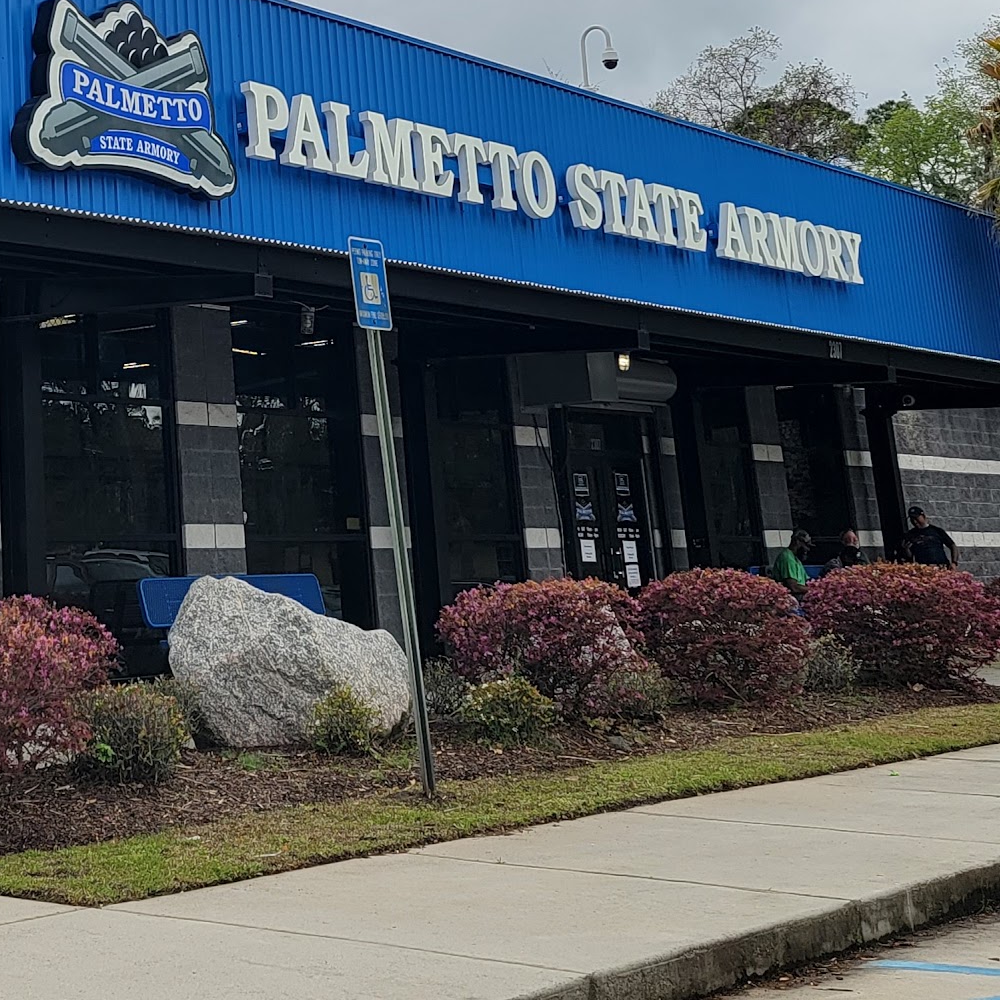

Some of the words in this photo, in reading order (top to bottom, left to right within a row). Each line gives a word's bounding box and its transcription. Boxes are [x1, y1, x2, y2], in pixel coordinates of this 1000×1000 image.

[72, 68, 203, 122] PALMETTO
[100, 135, 133, 151] STATE
[136, 140, 181, 165] ARMORY
[240, 80, 557, 219] PALMETTO
[566, 163, 707, 252] STATE
[716, 202, 864, 285] ARMORY
